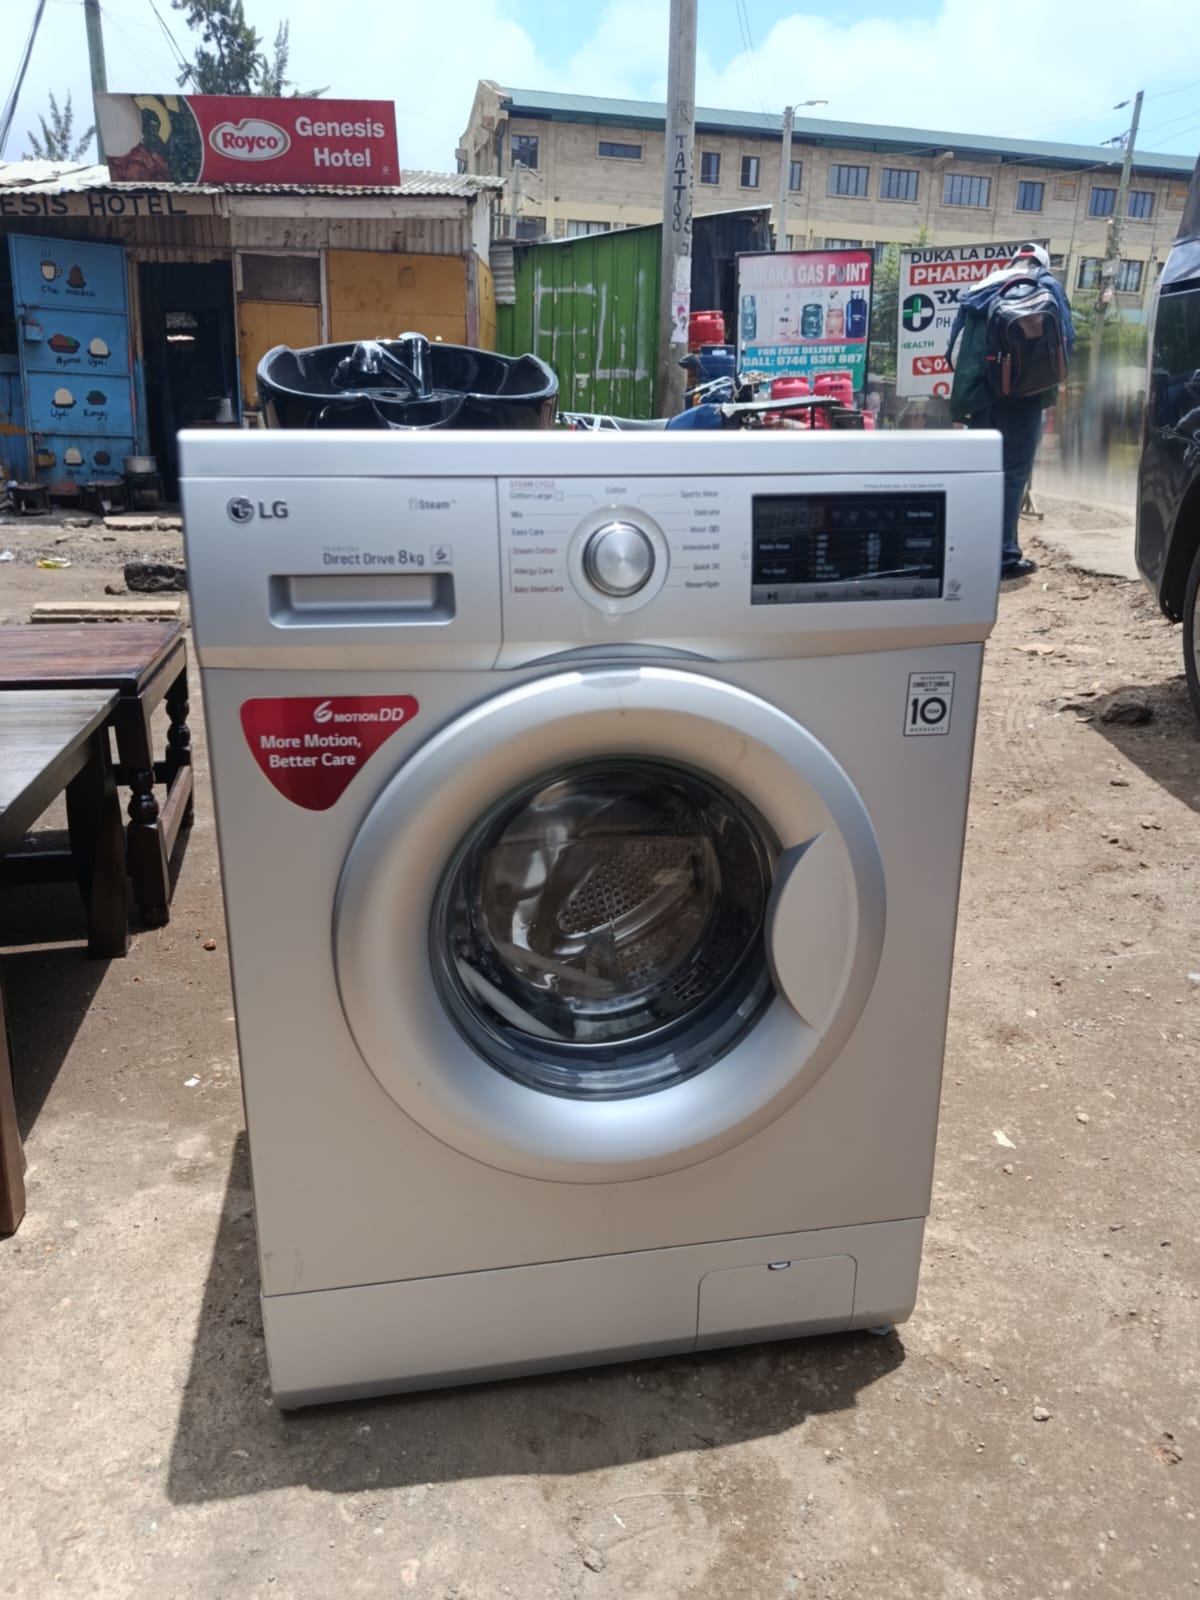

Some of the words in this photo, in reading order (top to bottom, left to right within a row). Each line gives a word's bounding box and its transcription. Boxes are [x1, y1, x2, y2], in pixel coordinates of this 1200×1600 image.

[295, 115, 385, 138] Genesis
[222, 132, 278, 153] Royco
[313, 147, 371, 168] Hotel
[87, 193, 187, 216] HOTEL
[911, 250, 957, 264] DUKA
[960, 248, 980, 261] LA
[797, 264, 824, 284] GAS
[827, 262, 869, 283] POINT
[758, 347, 776, 356] FOR
[778, 346, 796, 355] FREE
[802, 345, 847, 355] DELIVERY
[258, 500, 289, 519] LG
[323, 553, 361, 565] Direct
[363, 553, 395, 565] Drive
[398, 550, 425, 567] 8kg
[911, 696, 947, 725] 10
[260, 735, 300, 749] More
[304, 733, 361, 749] Motion,
[269, 754, 317, 768] Better
[321, 753, 356, 766] Care
